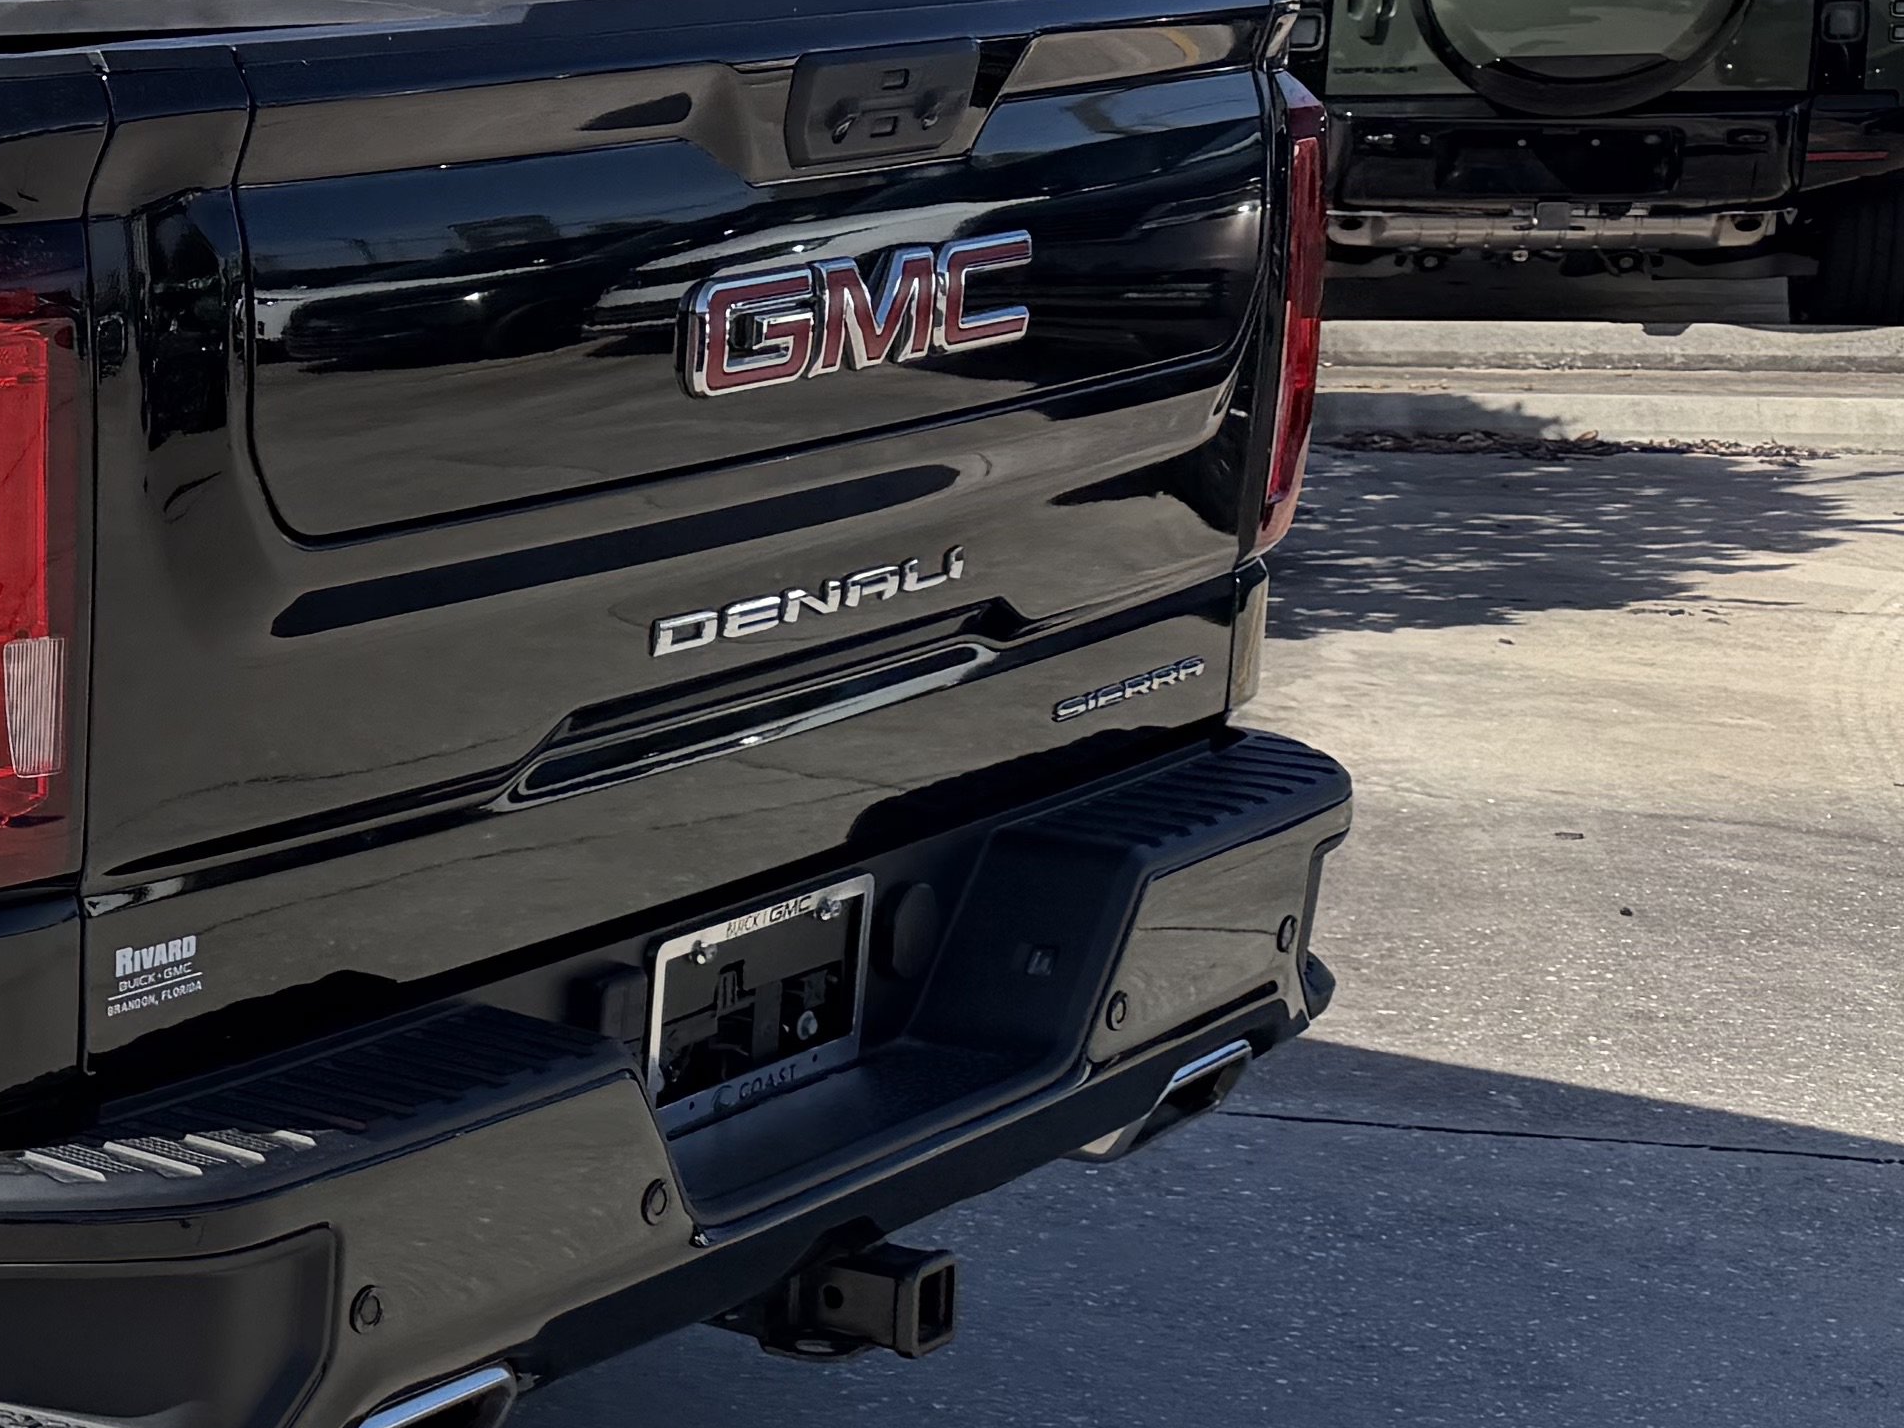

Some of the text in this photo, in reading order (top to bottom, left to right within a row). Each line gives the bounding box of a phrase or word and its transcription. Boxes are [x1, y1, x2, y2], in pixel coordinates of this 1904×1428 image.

[676, 229, 1033, 400] GMC
[649, 544, 966, 659] DENALI
[1052, 654, 1205, 723] SIERRA
[769, 895, 812, 922] GMC
[115, 935, 197, 978] RIVARD
[118, 961, 193, 993] BUICK GMC
[107, 980, 203, 1017] BRANDON, FLORIDA
